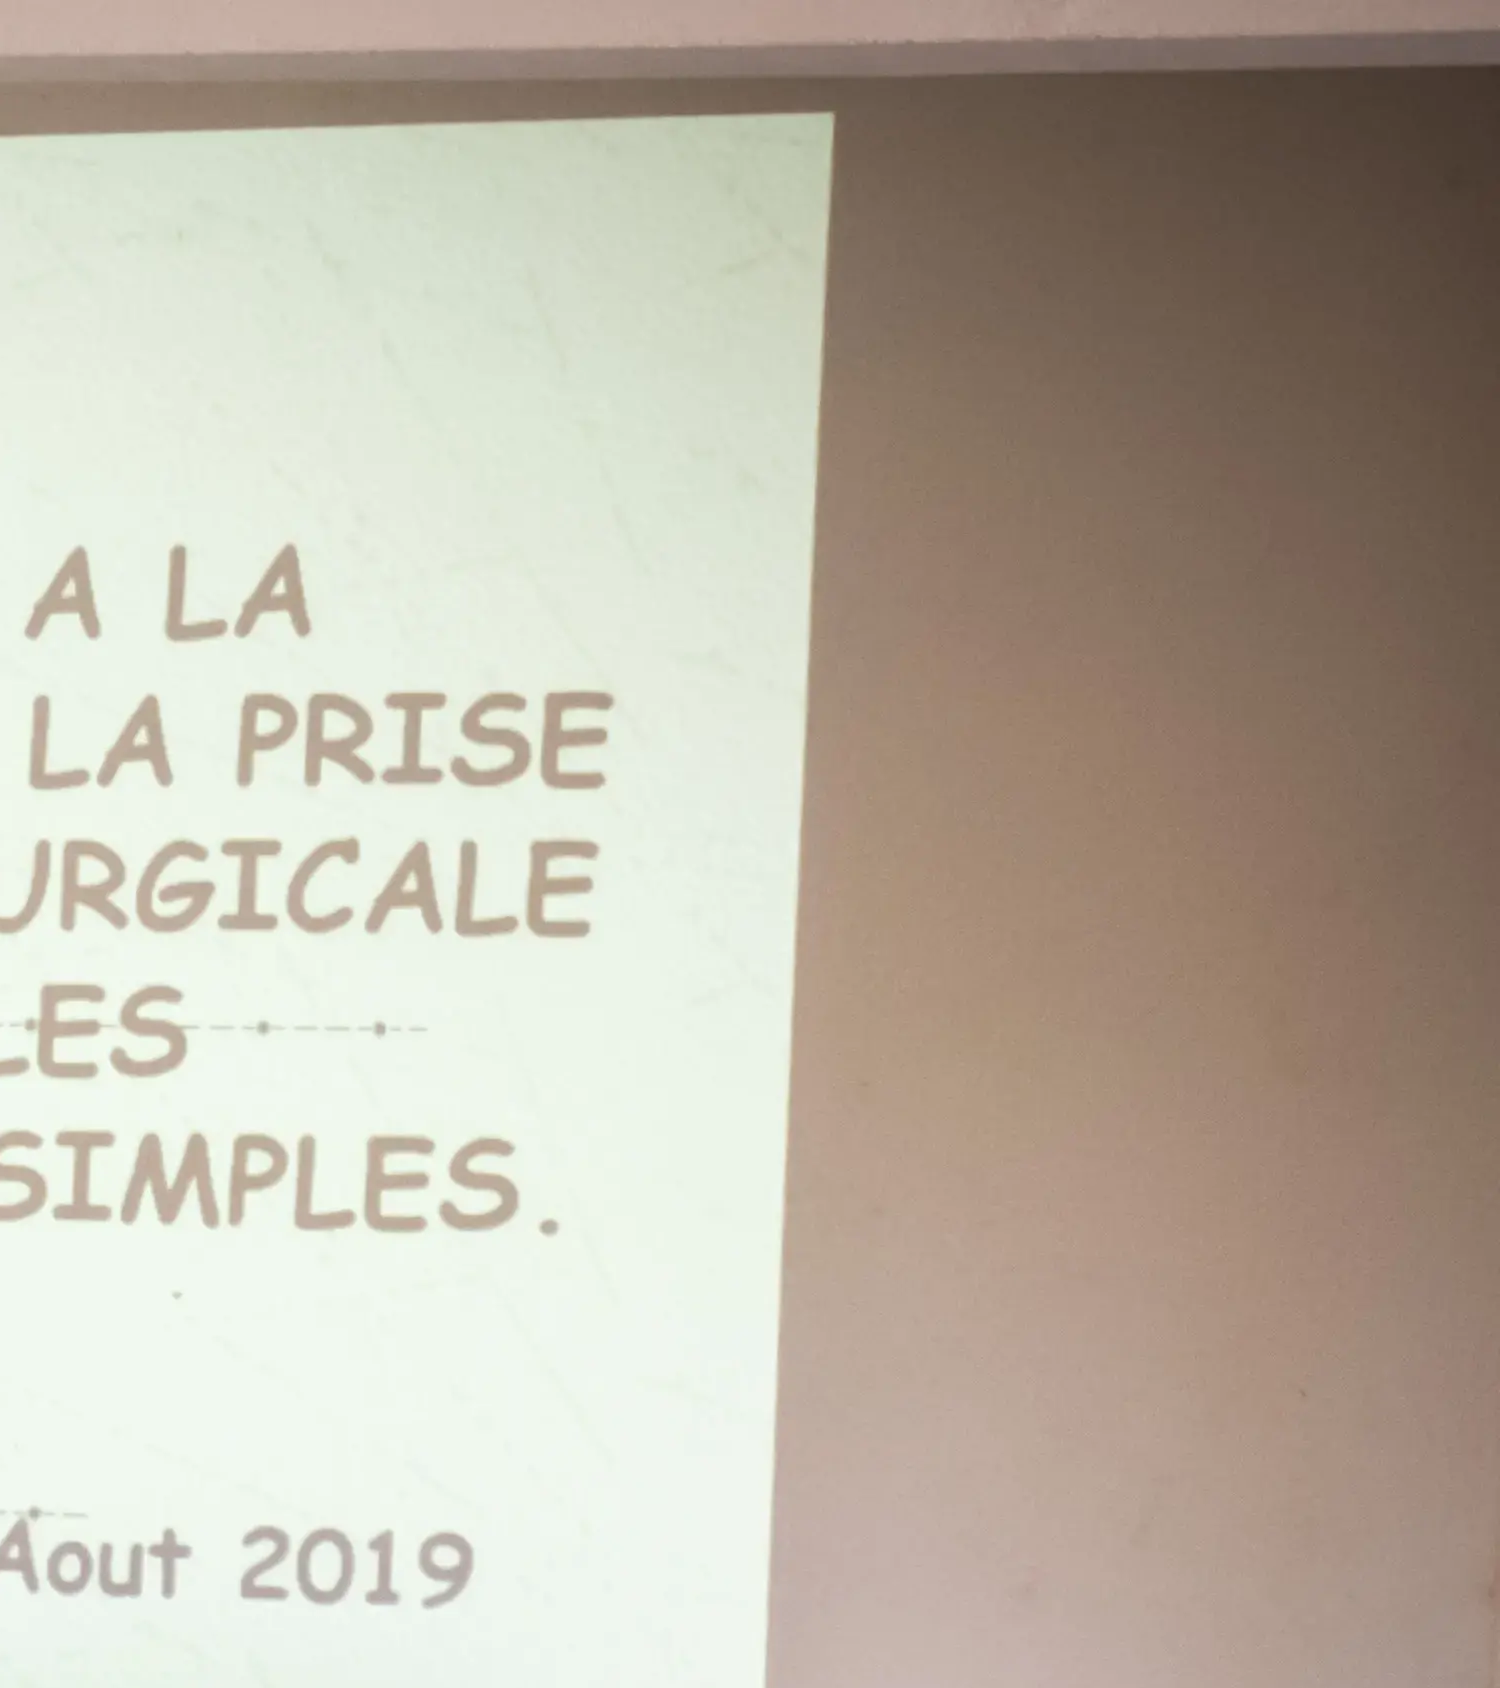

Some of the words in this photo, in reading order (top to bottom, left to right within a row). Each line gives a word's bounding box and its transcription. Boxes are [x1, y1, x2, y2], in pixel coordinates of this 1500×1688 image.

[23, 545, 102, 641] A
[164, 543, 312, 643] LA
[28, 693, 174, 791] LA
[236, 690, 615, 791] PRISE
[239, 1525, 474, 1610] 2019
